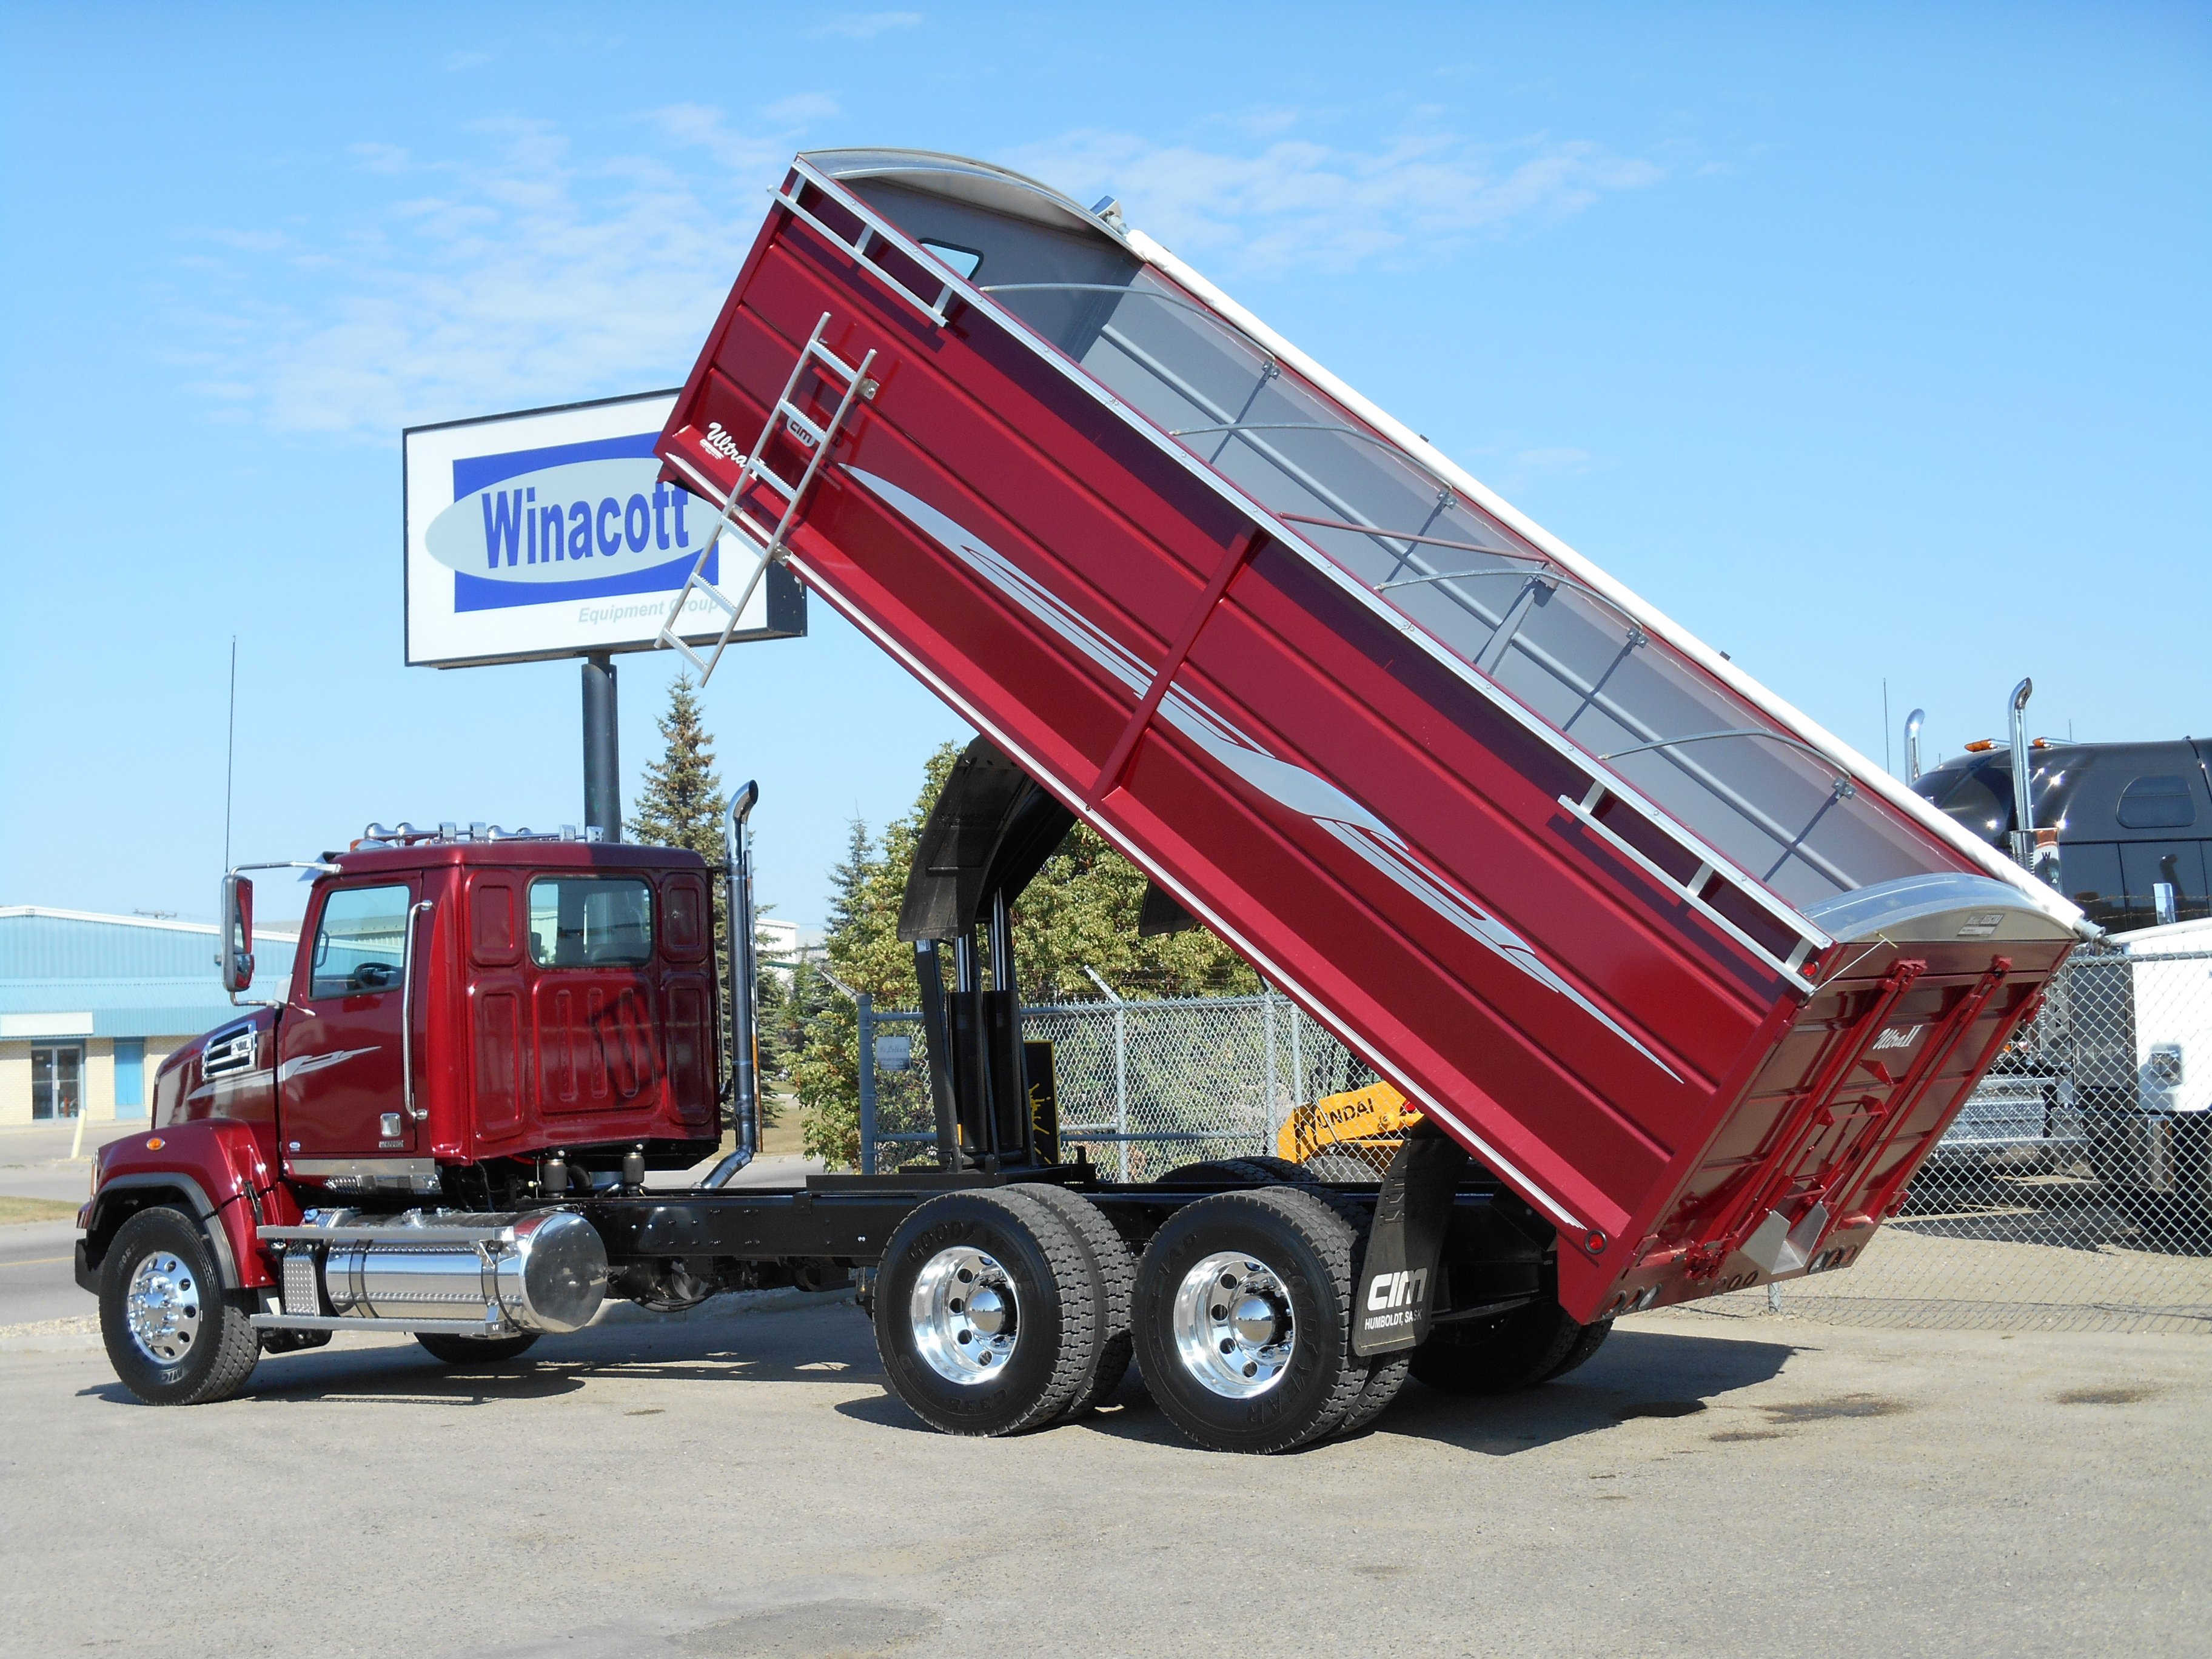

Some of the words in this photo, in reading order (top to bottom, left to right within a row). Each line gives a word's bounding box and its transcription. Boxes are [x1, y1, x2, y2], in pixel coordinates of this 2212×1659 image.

[706, 421, 747, 468] Ultra
[481, 481, 689, 569] Winacott
[578, 601, 665, 625] Equipment
[1317, 1098, 1374, 1128] UNDAI
[1367, 1267, 1428, 1311] CIM
[1365, 1312, 1404, 1330] HUMBOLDT,
[1404, 1309, 1423, 1323] SASK
